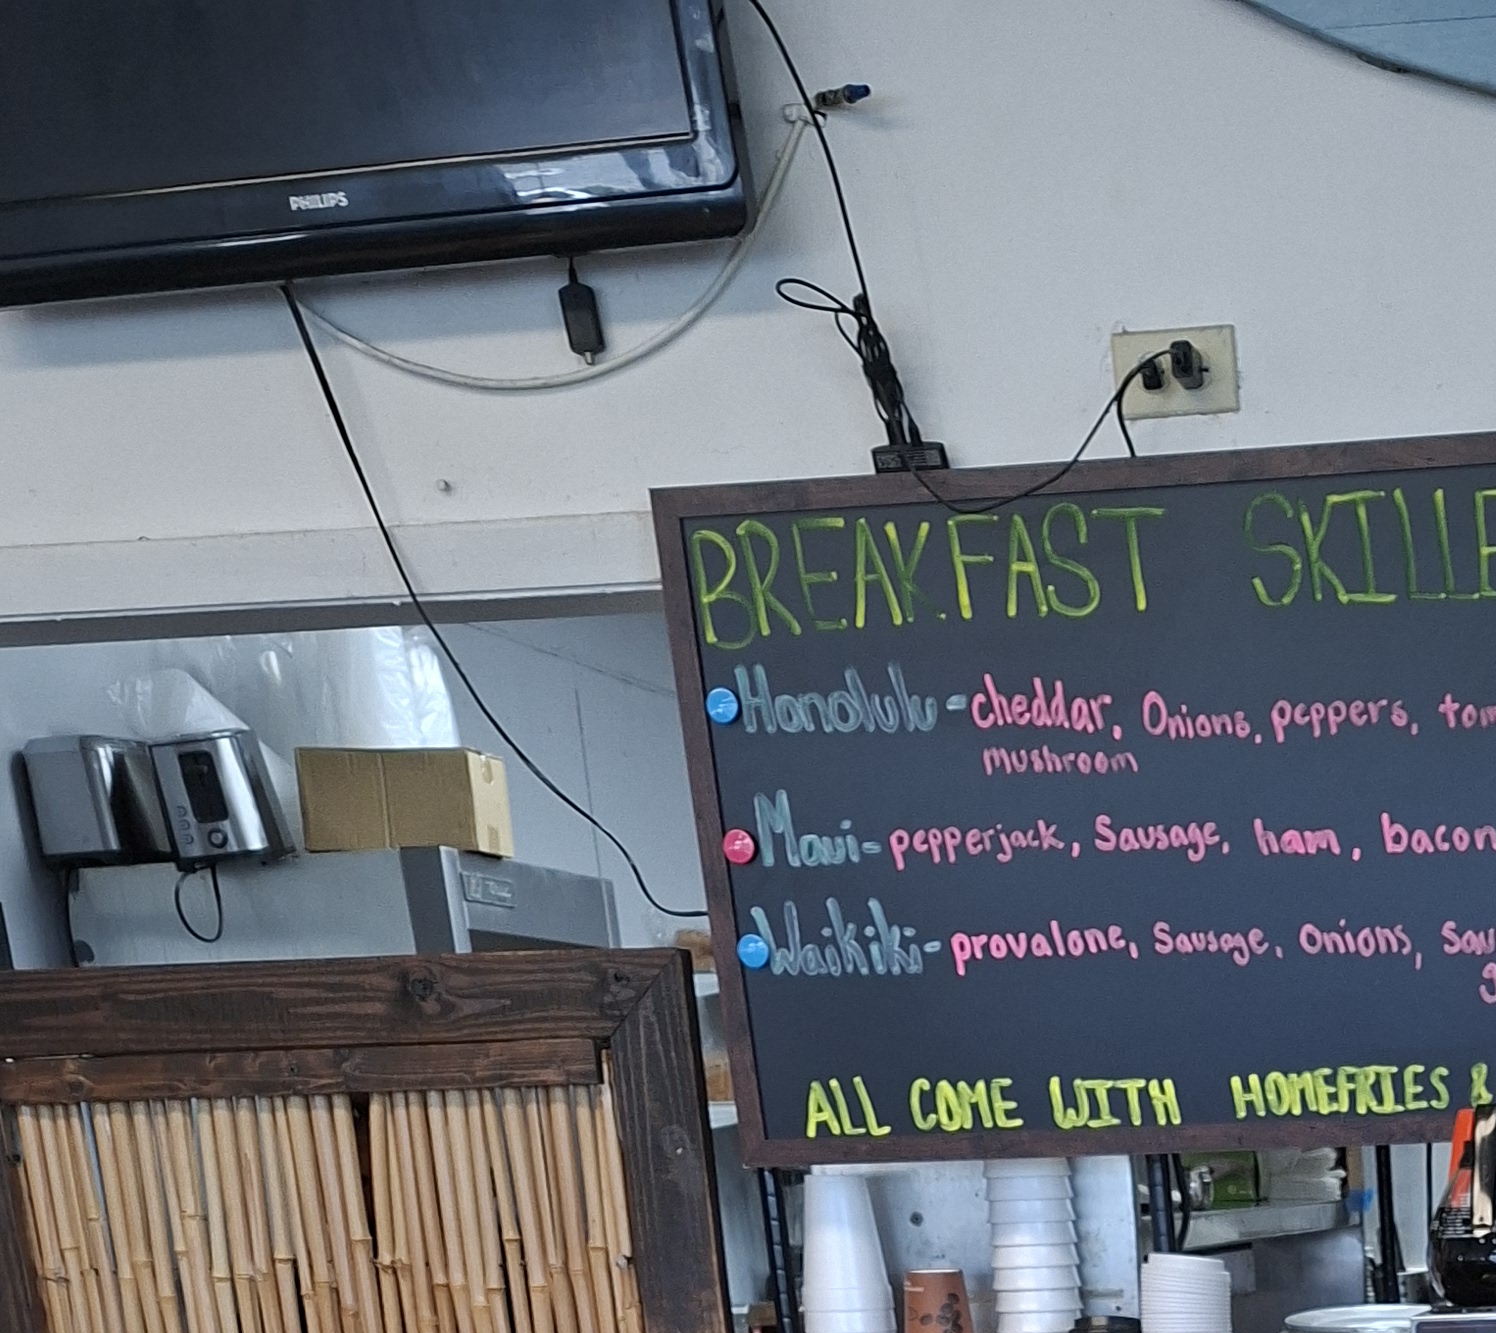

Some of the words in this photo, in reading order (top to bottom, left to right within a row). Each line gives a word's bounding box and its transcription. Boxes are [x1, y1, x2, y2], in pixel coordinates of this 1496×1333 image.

[691, 502, 1165, 650] BREAKFAST
[983, 744, 1139, 777] mushroom
[806, 1075, 893, 1139] ALL
[908, 1077, 1025, 1133] COME
[1048, 1075, 1182, 1129] WITH
[1229, 1063, 1451, 1120] HOMEFRIES
[1470, 1061, 1494, 1108] &
